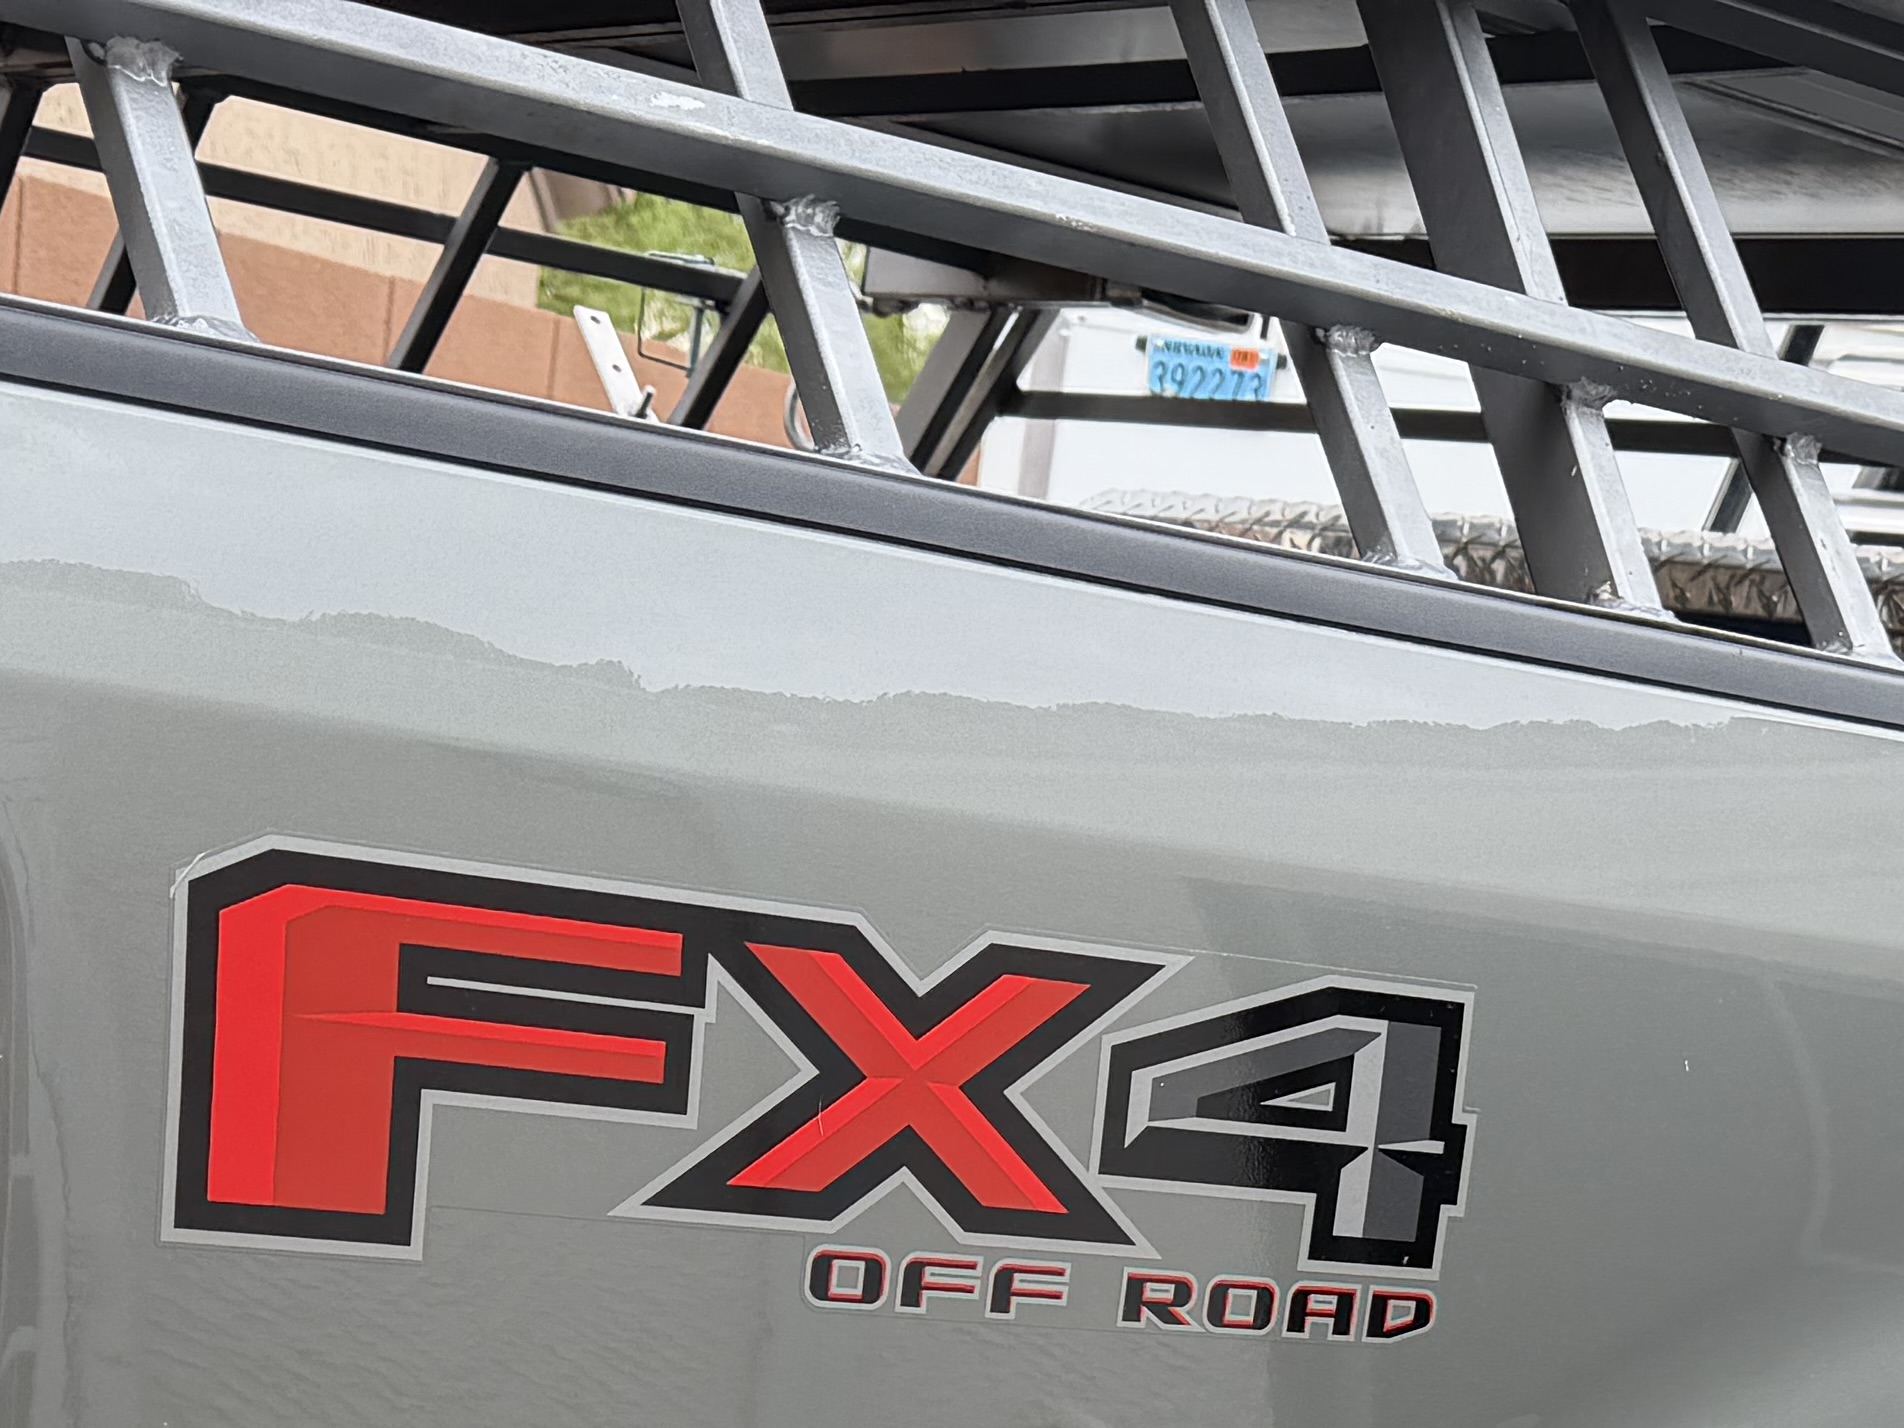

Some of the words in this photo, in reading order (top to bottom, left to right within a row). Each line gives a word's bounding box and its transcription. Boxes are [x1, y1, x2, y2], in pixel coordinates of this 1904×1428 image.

[161, 835, 1476, 1280] FX4
[805, 1248, 1071, 1319] OFF
[1118, 1266, 1436, 1342] ROAD
